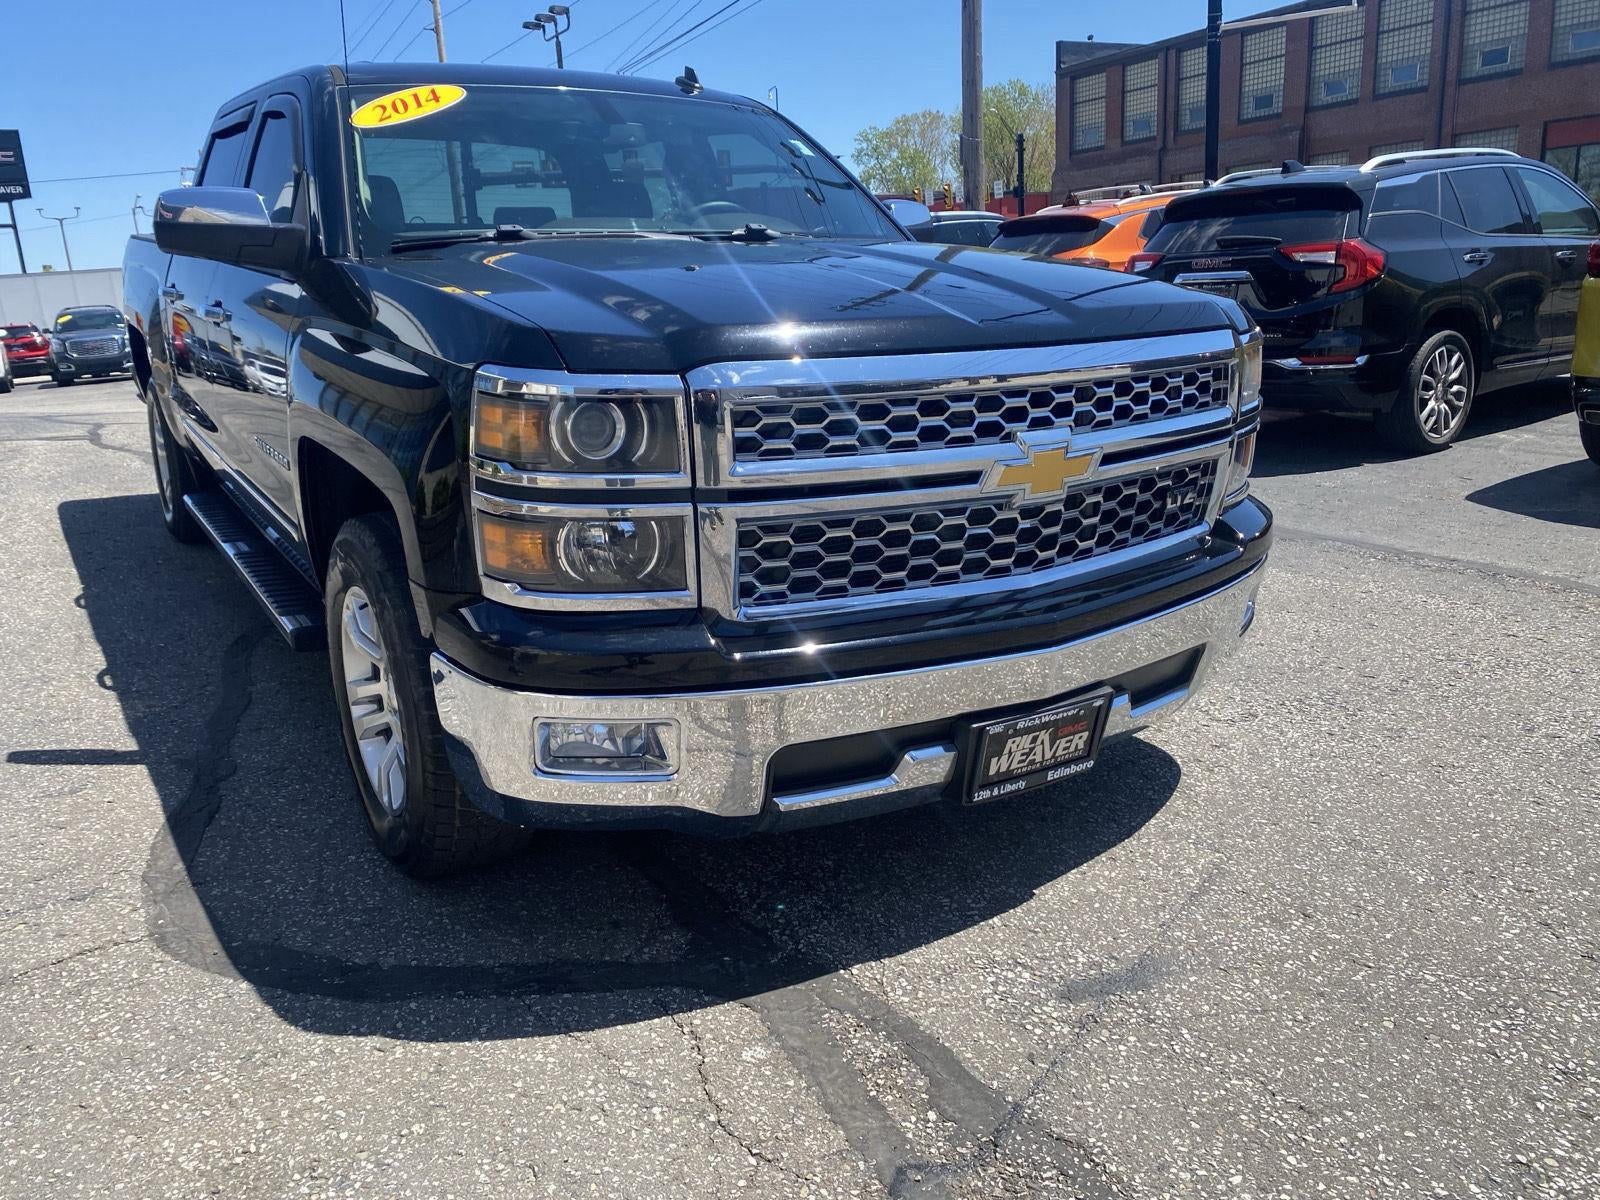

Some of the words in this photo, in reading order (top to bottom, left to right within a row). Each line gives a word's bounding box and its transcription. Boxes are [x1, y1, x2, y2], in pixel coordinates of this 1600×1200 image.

[372, 88, 441, 123] 2014
[1003, 727, 1055, 755] RICK
[1057, 721, 1088, 737] GMC
[988, 731, 1090, 777] WEAVER
[1047, 760, 1095, 781] Edinboro
[973, 792, 991, 802] 12th
[992, 787, 999, 796] &
[1001, 780, 1027, 794] Liberty
